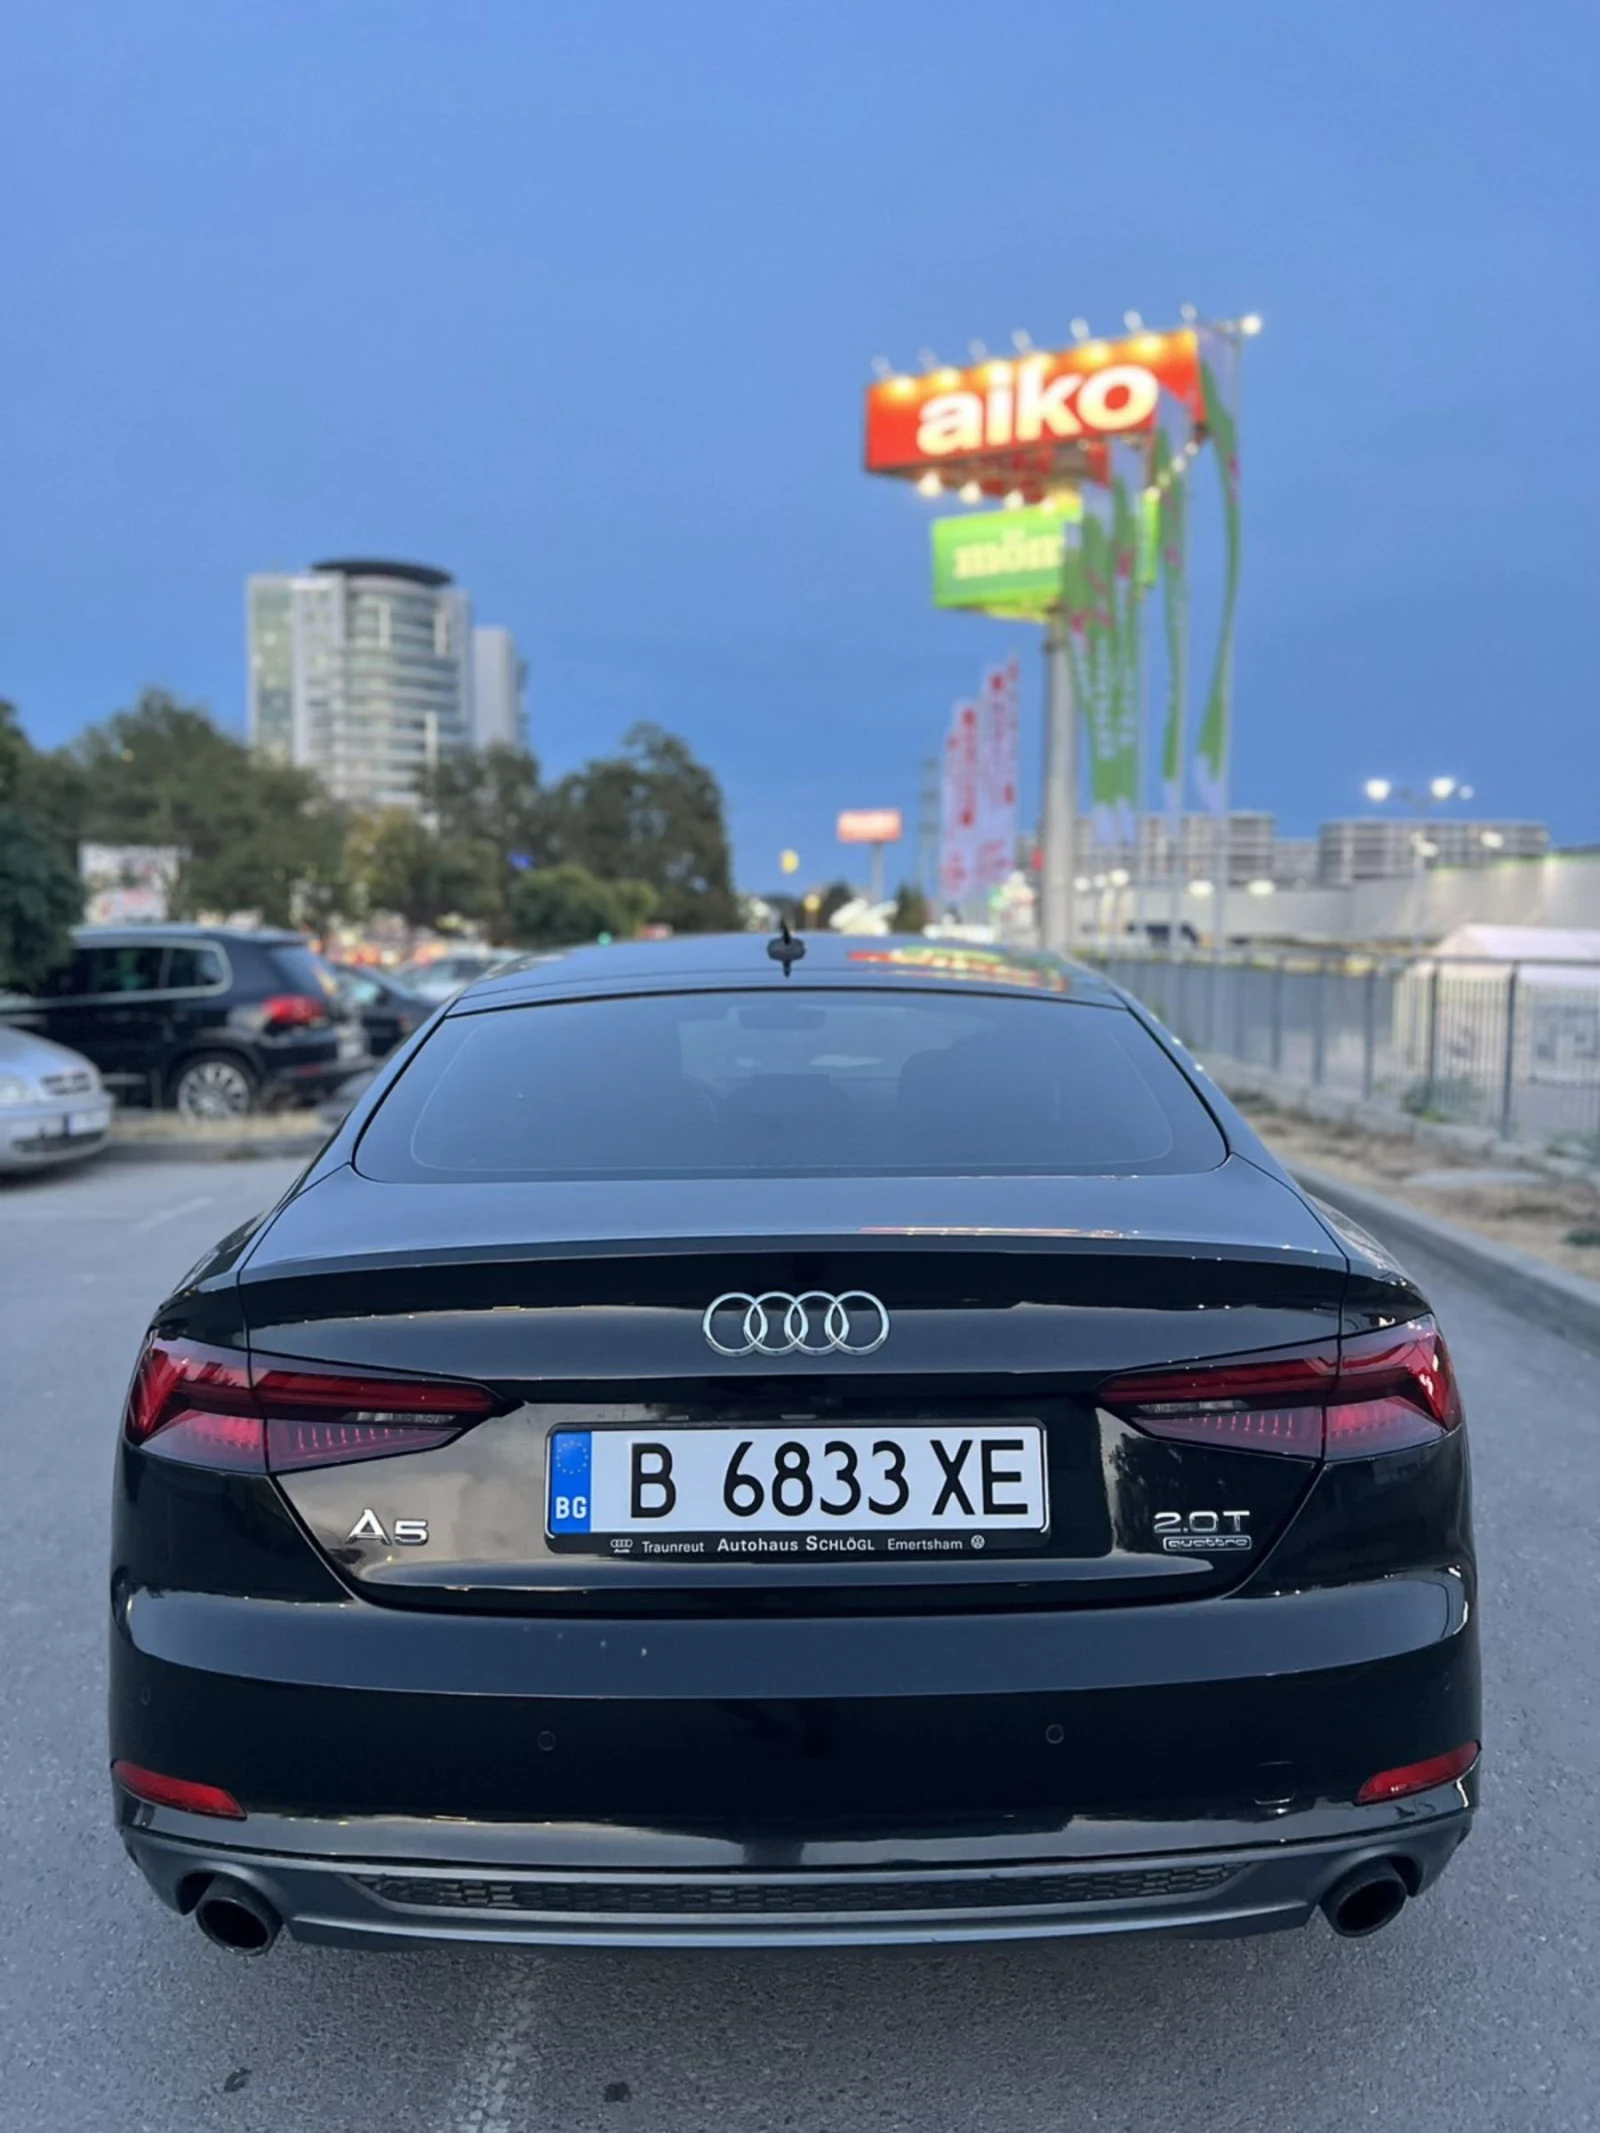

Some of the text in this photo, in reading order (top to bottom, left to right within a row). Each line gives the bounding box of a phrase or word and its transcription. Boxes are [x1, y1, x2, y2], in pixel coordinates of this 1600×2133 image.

[917, 358, 1159, 456] aiko
[631, 1439, 1029, 1519] B 6833 XE
[555, 1496, 587, 1520] BG
[345, 1508, 429, 1546] A5
[641, 1541, 705, 1554] Traunreut
[717, 1537, 799, 1552] Autohaus
[887, 1537, 963, 1551] Emertsham
[1167, 1537, 1249, 1549] quattro
